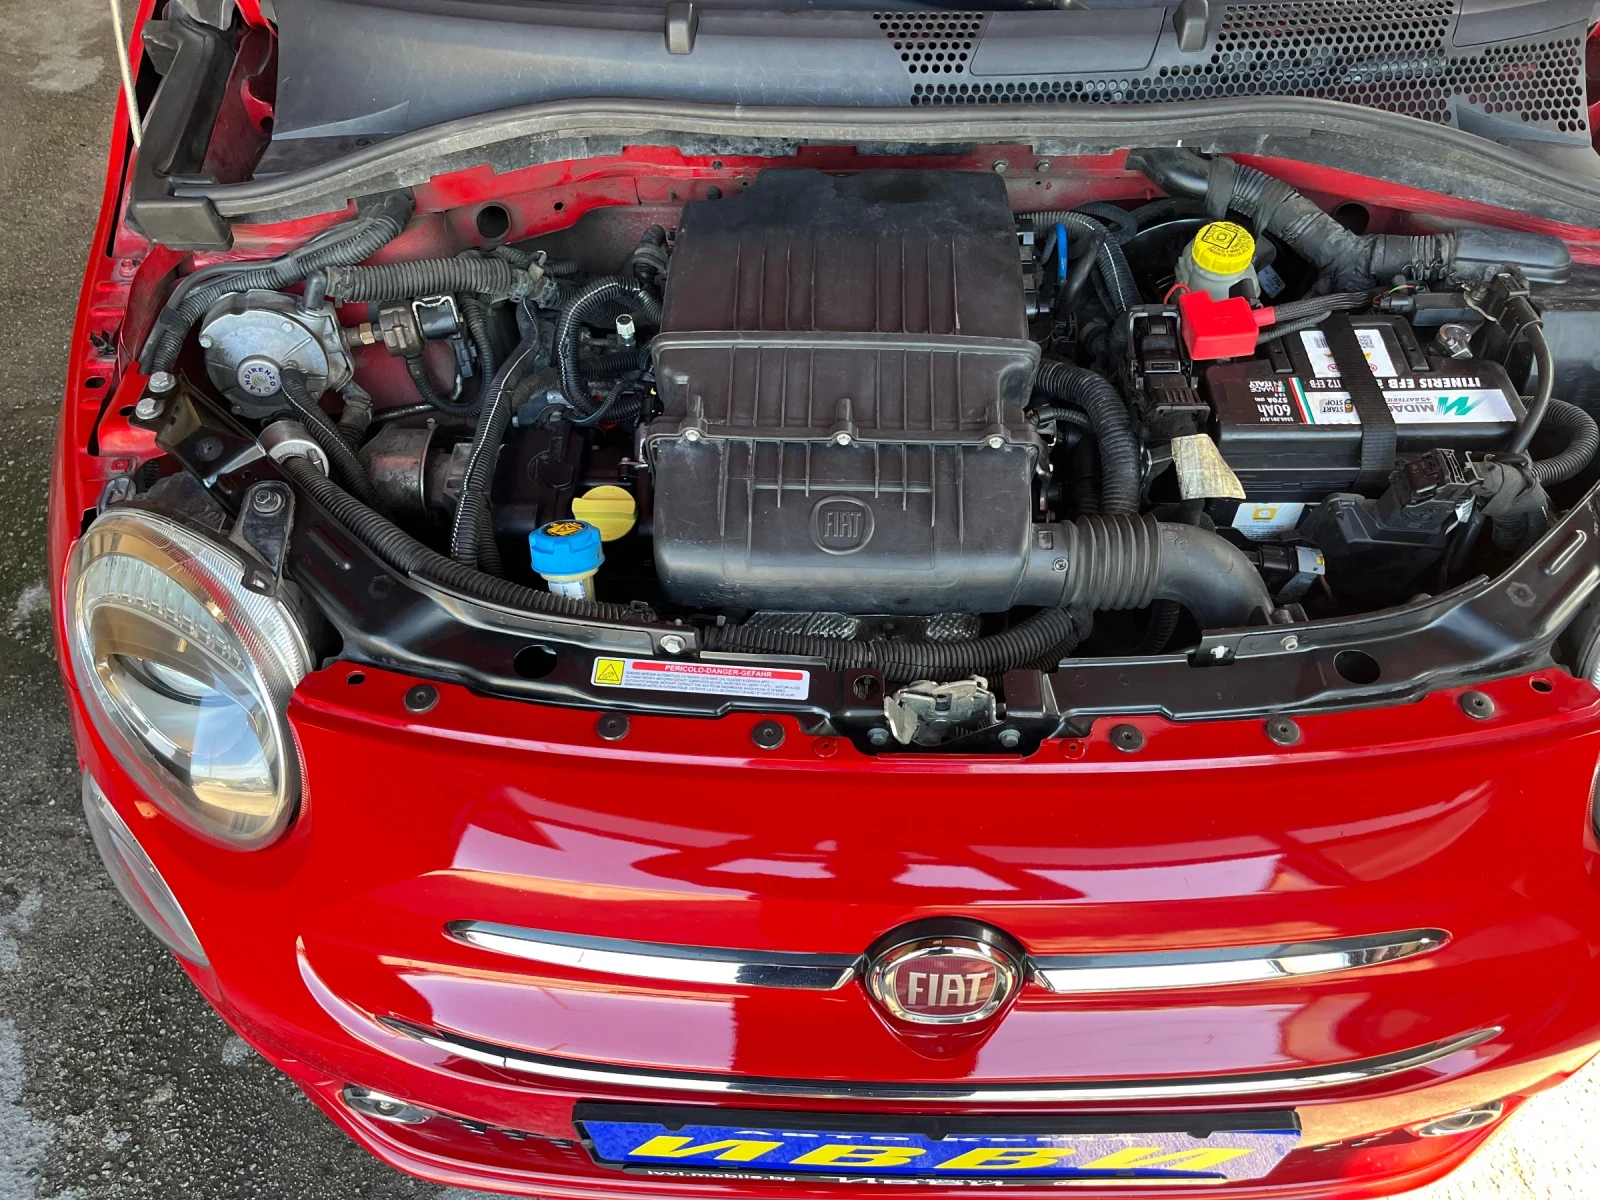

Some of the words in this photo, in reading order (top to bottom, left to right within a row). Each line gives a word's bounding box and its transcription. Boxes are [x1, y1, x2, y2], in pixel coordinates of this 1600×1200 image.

[1248, 380, 1272, 388] ITALY
[1309, 380, 1326, 388] EFB
[1326, 380, 1342, 388] IT2
[1387, 378, 1416, 389] EFB
[1418, 377, 1482, 388] ITINERIS
[1256, 404, 1291, 417] 60Ah
[823, 511, 863, 539] FIAT
[664, 664, 772, 678] PERICOLO-DANGER-GEFAHR
[908, 971, 989, 1007] FIAT
[628, 1136, 1256, 1170] ИВВИ
